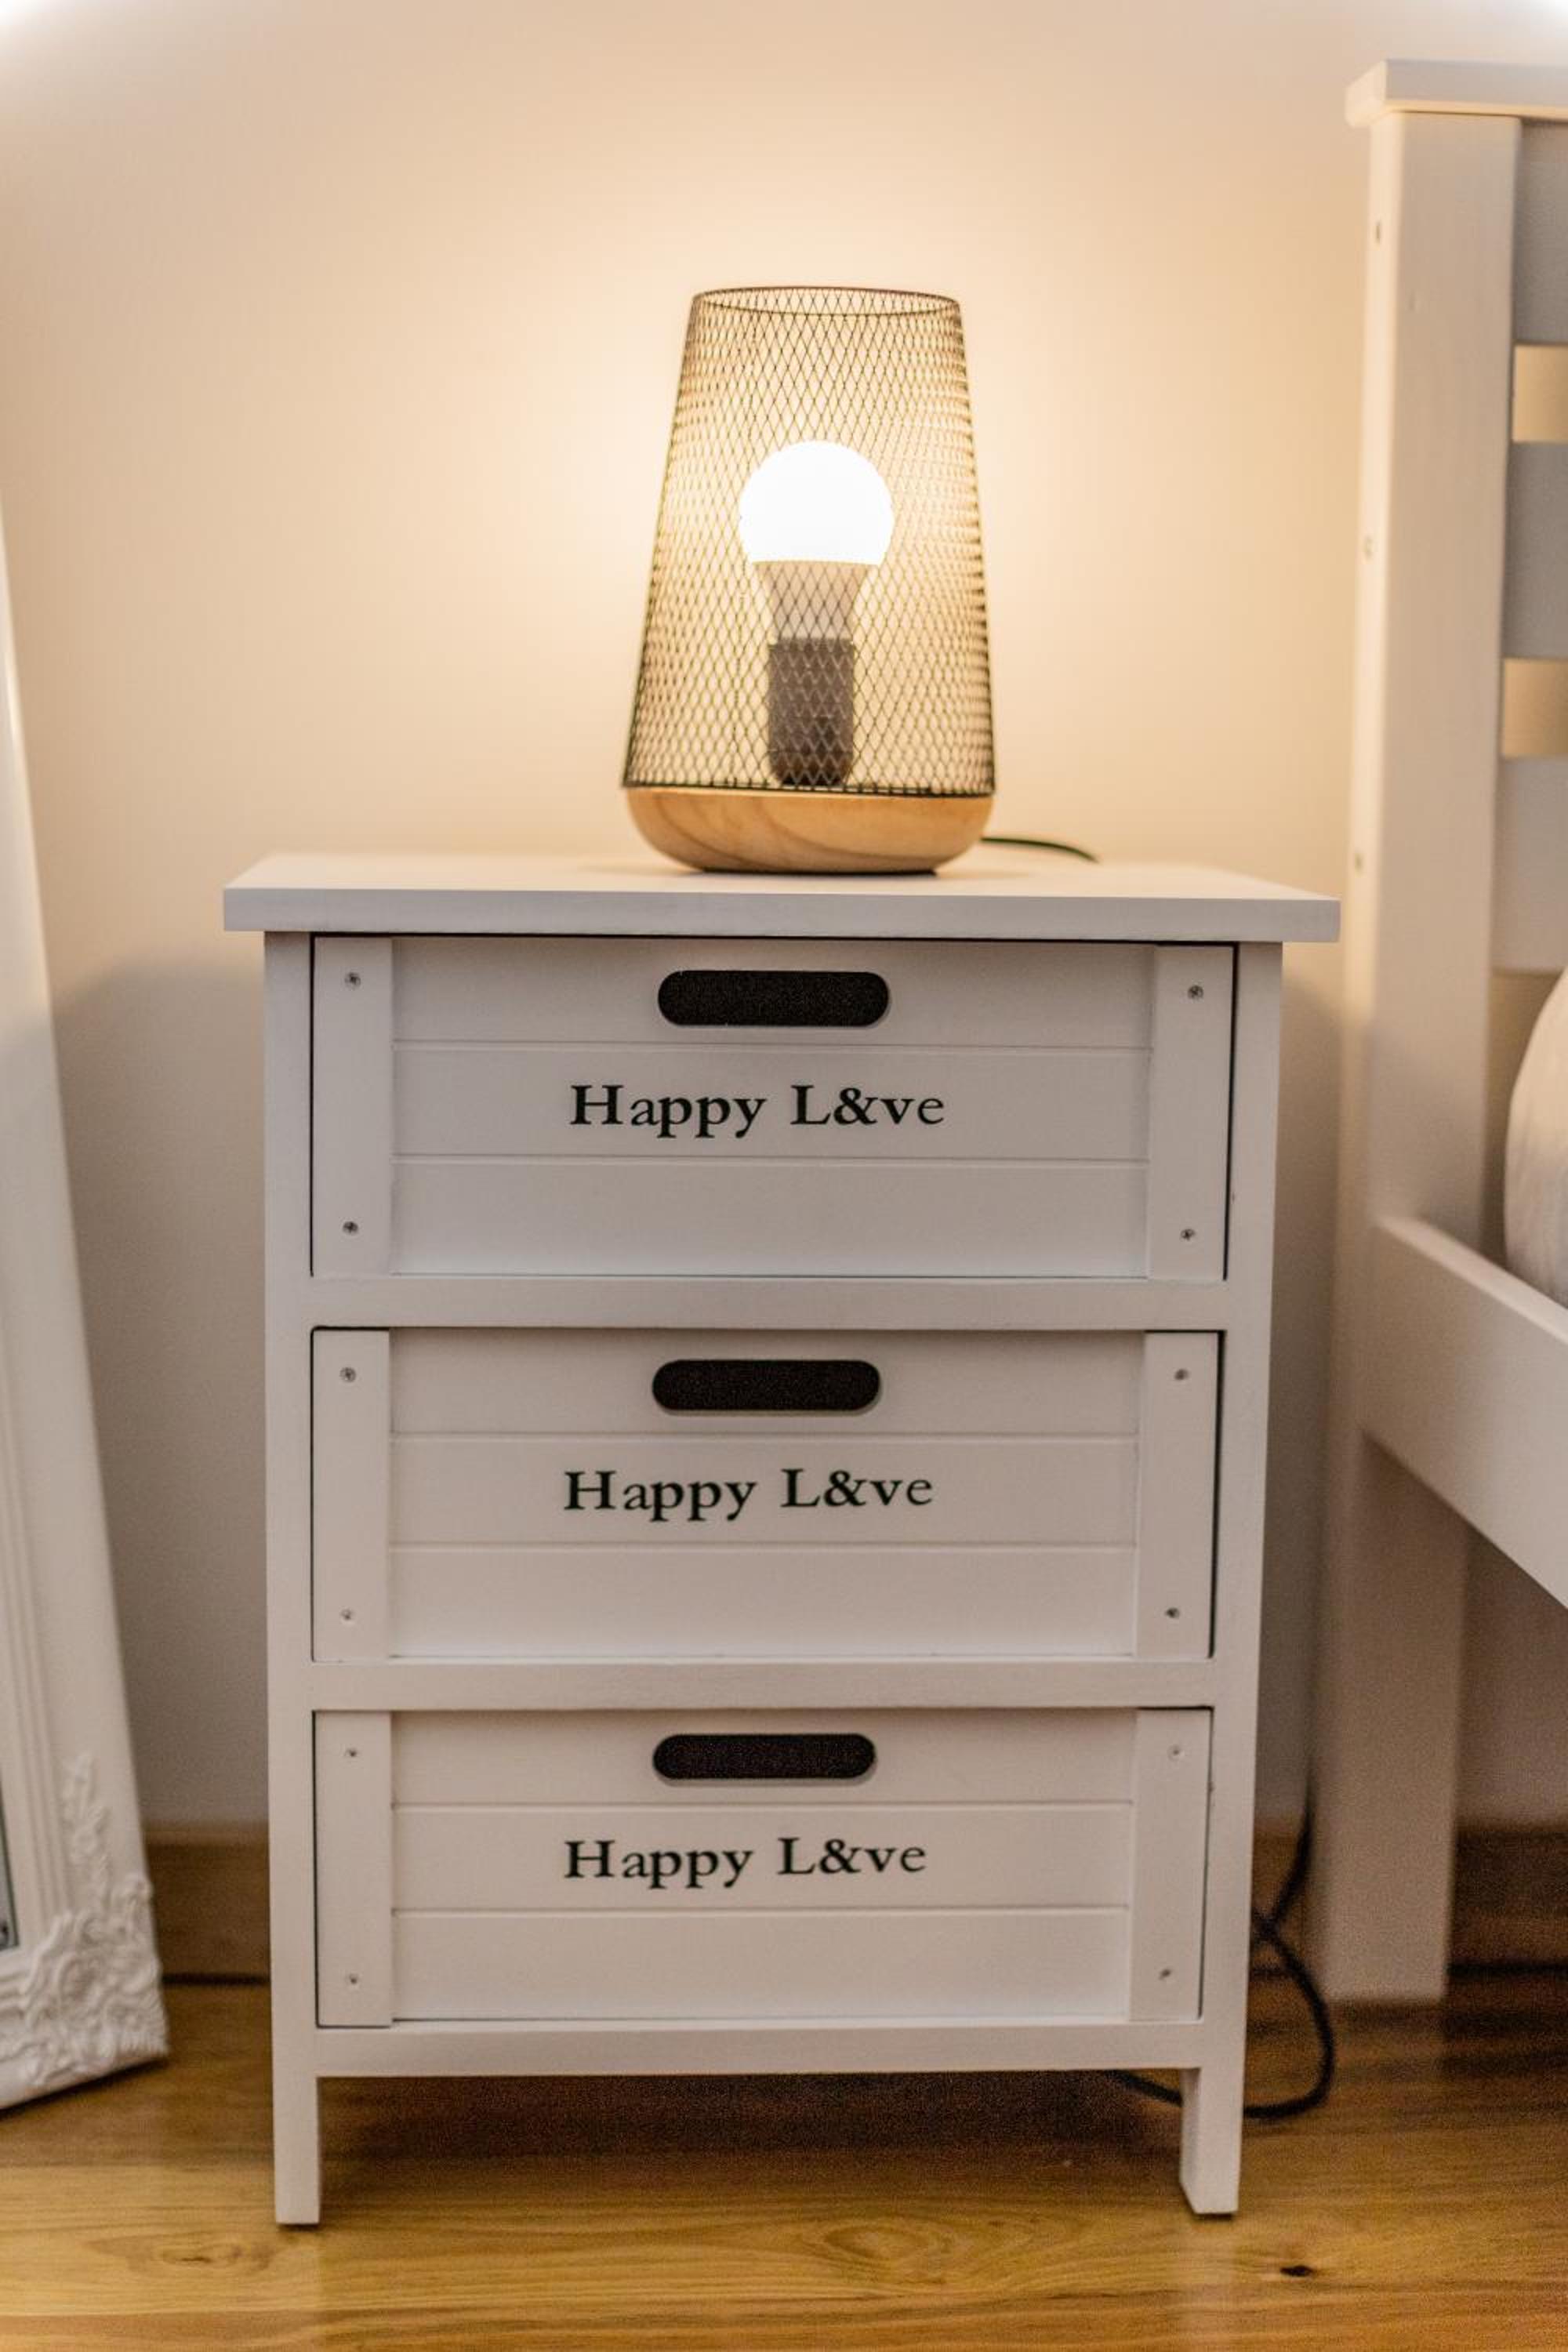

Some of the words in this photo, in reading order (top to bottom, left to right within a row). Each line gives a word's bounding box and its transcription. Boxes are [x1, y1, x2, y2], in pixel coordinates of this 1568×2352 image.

[569, 1084, 768, 1139] Happy
[789, 1084, 945, 1127] L&ve
[564, 1468, 757, 1523] Happy
[780, 1468, 933, 1508] L&ve
[564, 1840, 753, 1890] Happy
[777, 1837, 926, 1875] L&ve
